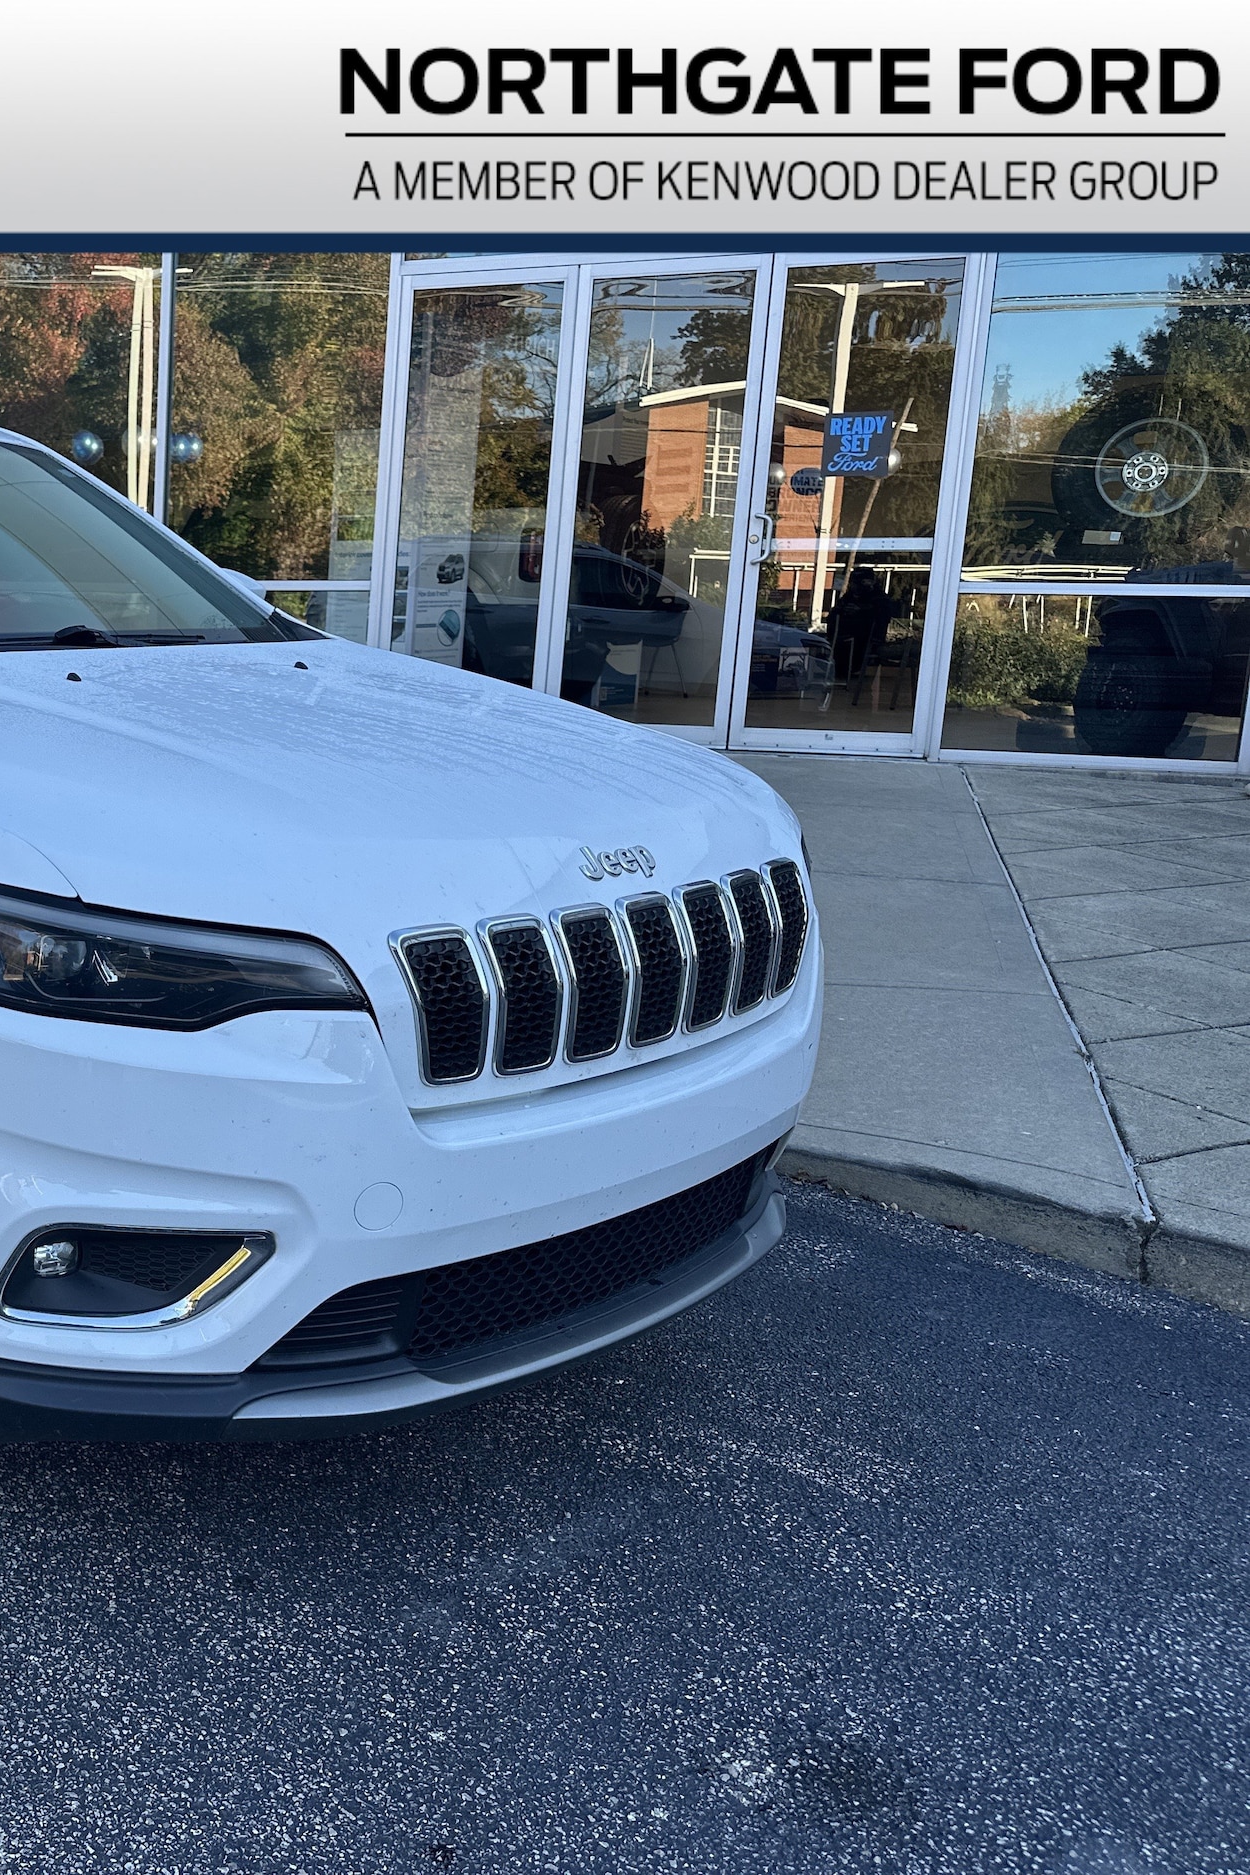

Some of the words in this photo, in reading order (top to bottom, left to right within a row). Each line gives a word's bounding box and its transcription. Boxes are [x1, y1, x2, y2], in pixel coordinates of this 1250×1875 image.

[830, 416, 887, 436] READY
[840, 434, 873, 452] SET
[827, 452, 878, 472] Ford
[579, 845, 656, 882] Jeep
